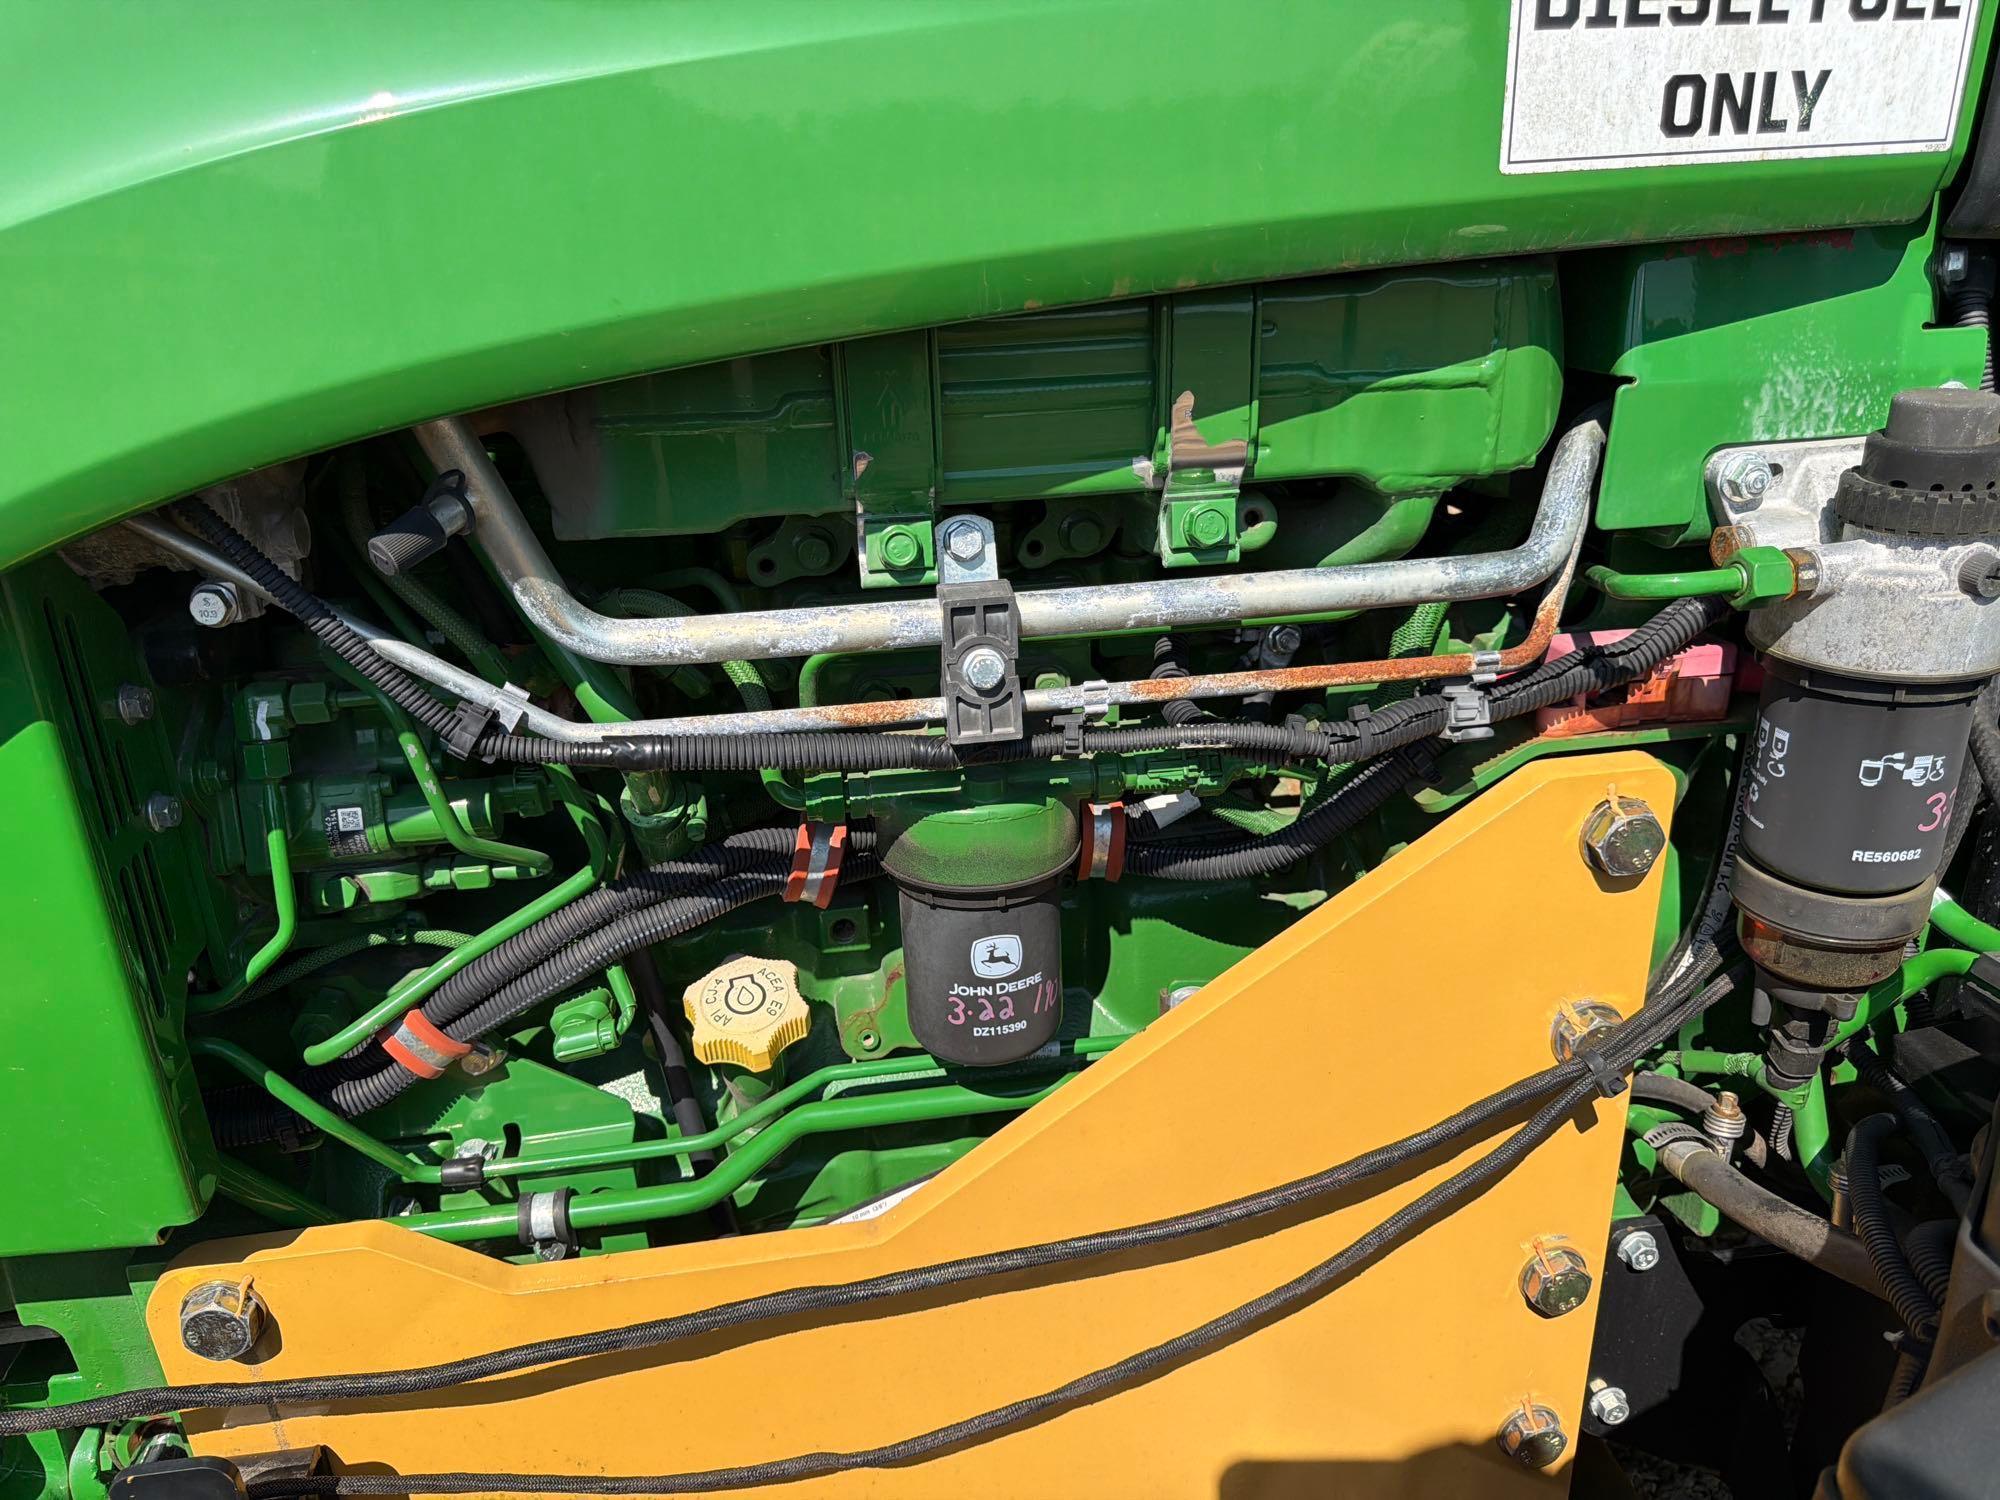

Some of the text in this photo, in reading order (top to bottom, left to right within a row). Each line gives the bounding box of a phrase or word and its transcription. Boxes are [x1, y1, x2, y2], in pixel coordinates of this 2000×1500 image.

[1659, 69, 1832, 139] ONLY
[1852, 848, 1921, 863] RE560682
[705, 978, 733, 1027] API CJ-4
[757, 967, 785, 1017] ACEA E9
[948, 971, 1043, 997] JOHN DEERE
[973, 1019, 1027, 1037] DZ115390
